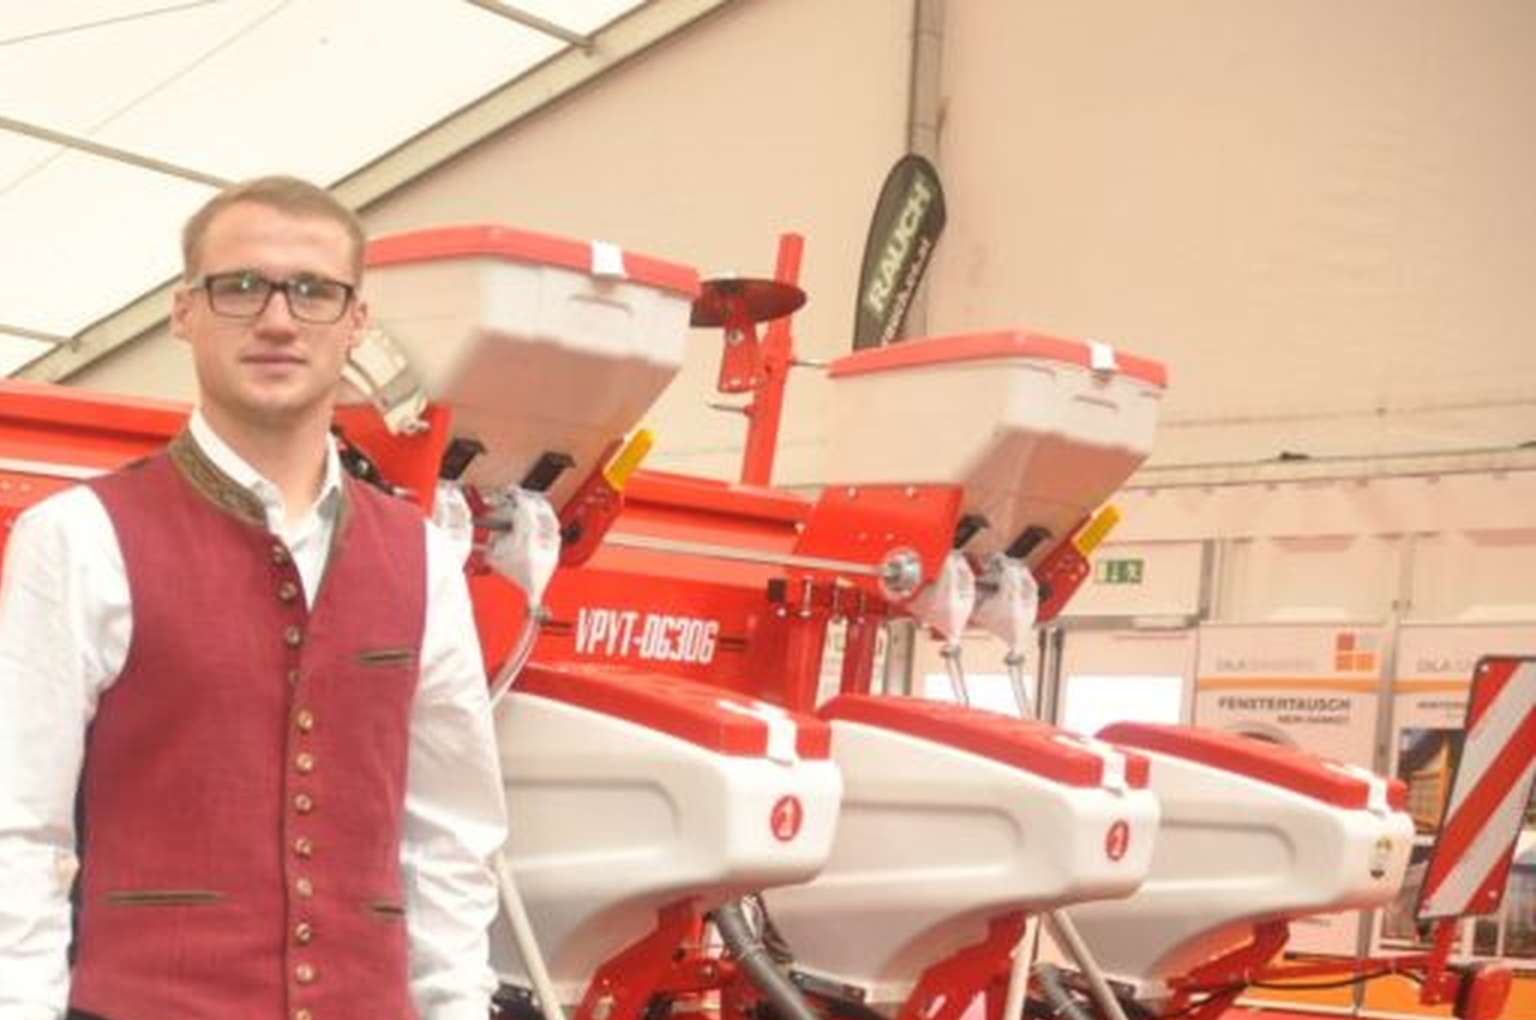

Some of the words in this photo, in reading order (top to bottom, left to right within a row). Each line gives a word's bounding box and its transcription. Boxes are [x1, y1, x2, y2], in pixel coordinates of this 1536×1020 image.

[869, 181, 931, 314] RAUCH
[576, 607, 720, 665] VPYT-DG306
[1217, 696, 1351, 711] FENSTERTAUSCH
